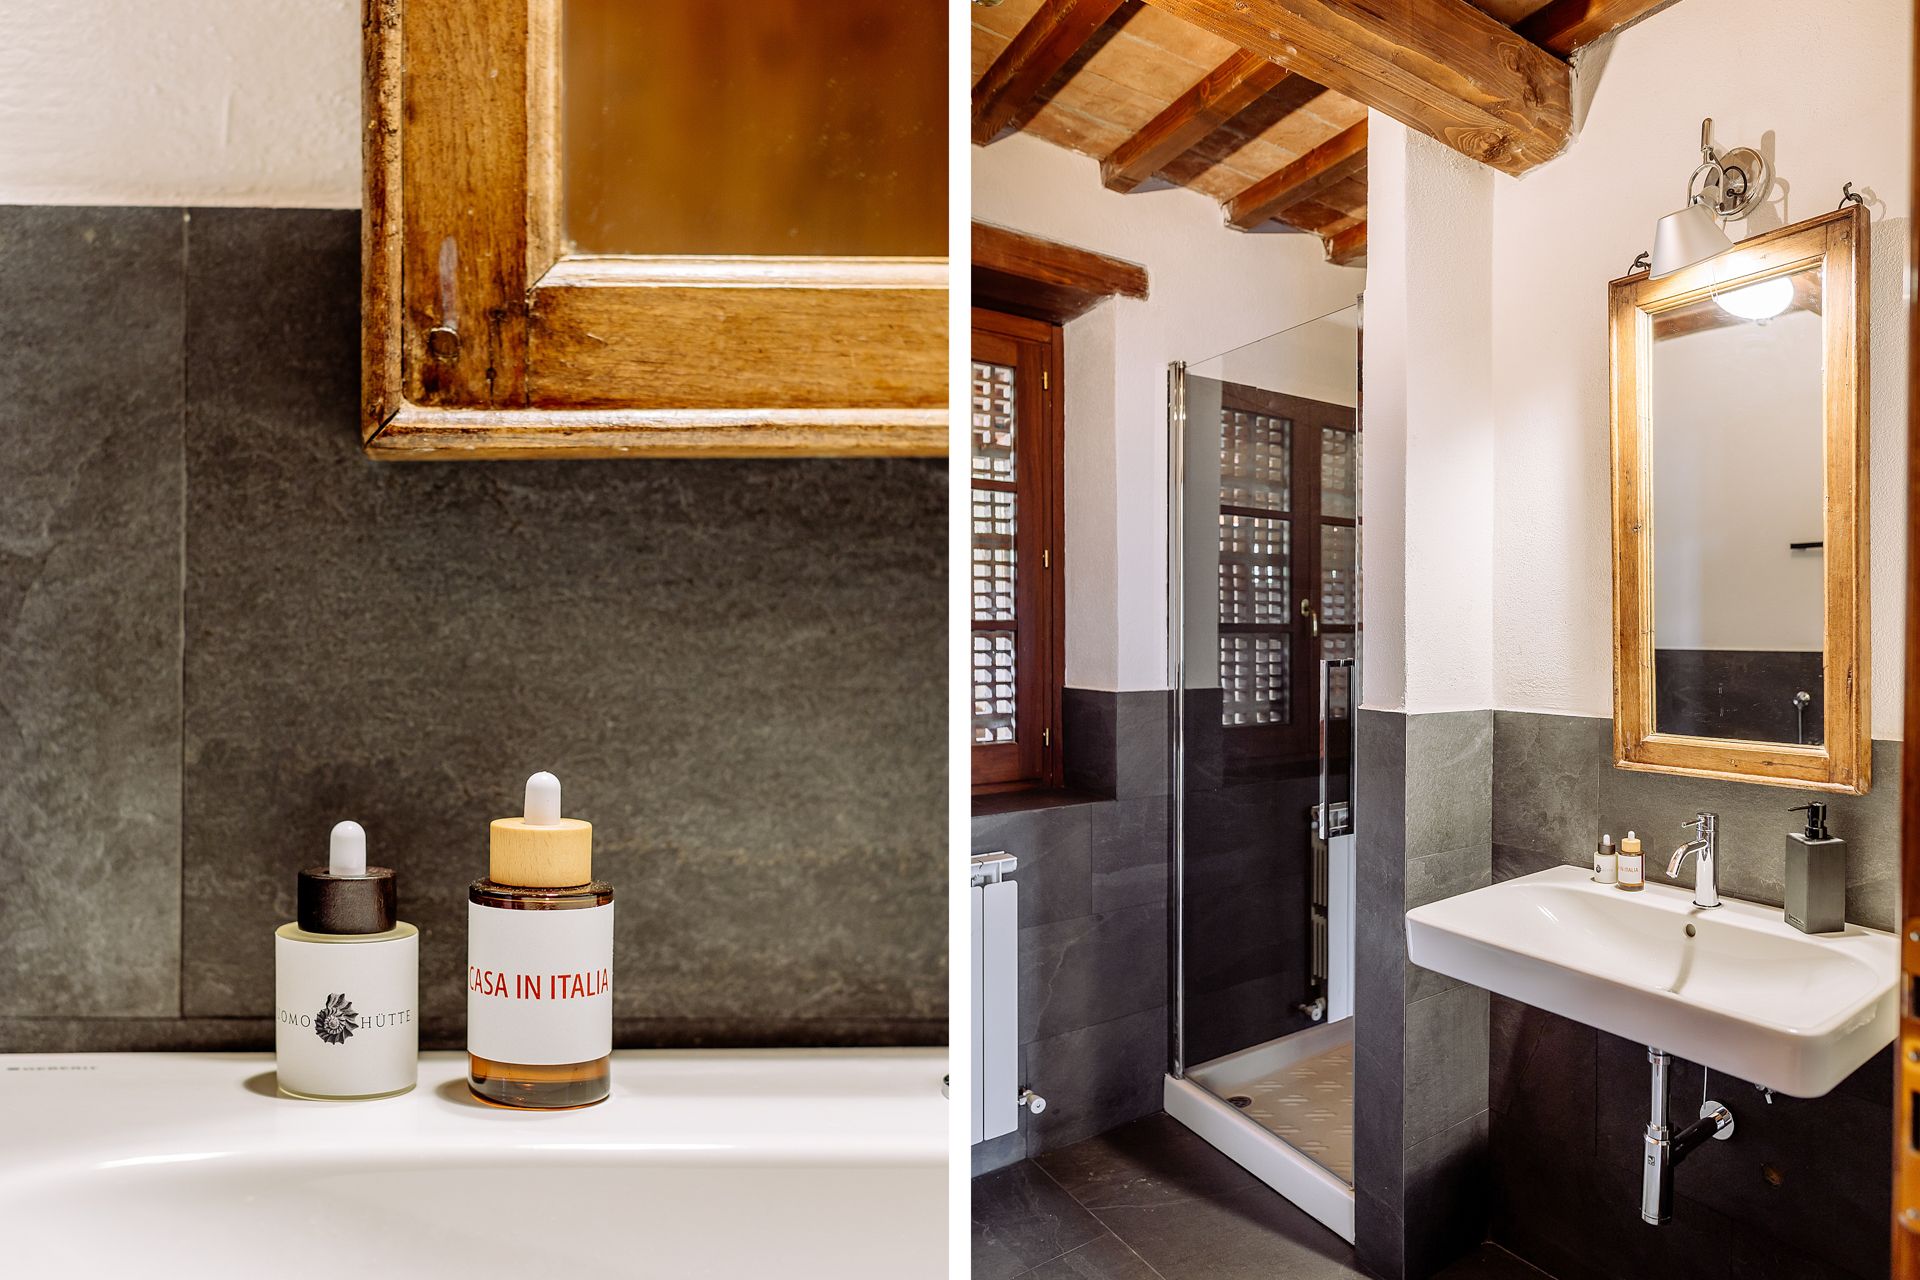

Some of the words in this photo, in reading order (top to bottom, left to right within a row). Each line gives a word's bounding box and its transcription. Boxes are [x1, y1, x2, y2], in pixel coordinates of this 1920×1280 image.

[469, 965, 509, 998] CASA
[516, 974, 541, 1000] IN
[550, 967, 609, 1000] ITALIA
[278, 1008, 311, 1028] OMO
[361, 1009, 411, 1029] HÜTTE
